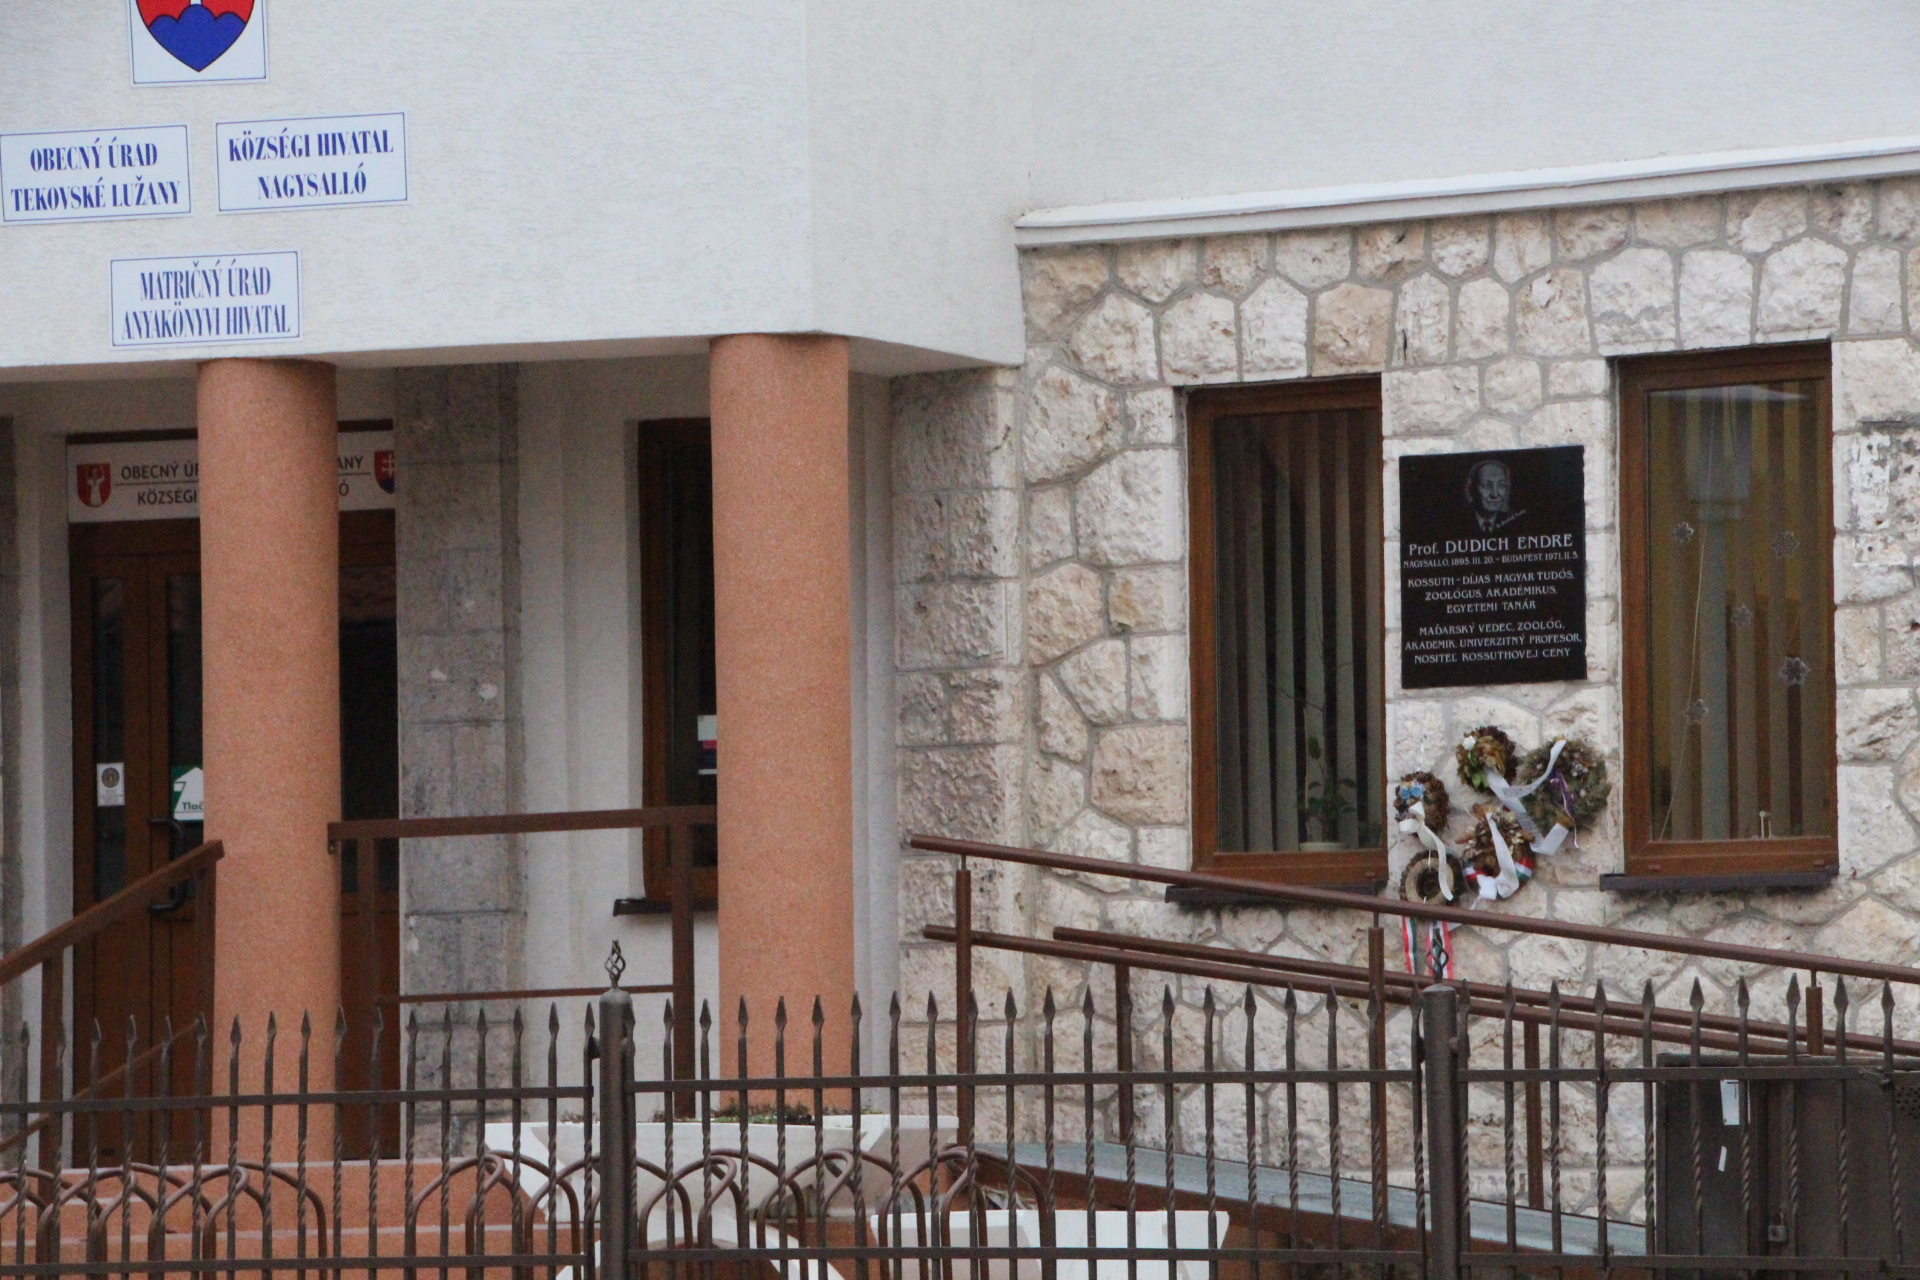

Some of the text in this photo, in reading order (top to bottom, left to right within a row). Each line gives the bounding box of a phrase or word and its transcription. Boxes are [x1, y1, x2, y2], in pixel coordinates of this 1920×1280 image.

[30, 136, 158, 172] OBECNÝ ÚRAD
[229, 127, 394, 162] KÖZSÉGI HIVATAL
[258, 162, 367, 200] NAGYSALLÓ
[11, 175, 180, 212] TEKOVSKÉ LUŽANY
[140, 258, 271, 300] MATRIČNÝ ÚRAD
[122, 301, 291, 340] ANYAKÖNYVI HIVATAL
[121, 461, 178, 480] OBECNÝ
[137, 487, 197, 505] KÖZSÉGI
[1409, 533, 1573, 556] Prof. DUDICH ENDRE
[1494, 572, 1535, 583] MAGYAR
[1486, 584, 1558, 597] AKADÉMIKUS,
[1446, 597, 1536, 614] EGYETEMI TANÁR
[1419, 617, 1566, 636] MAĎARSKÝ VEDEC, ZOOLÓG,
[1459, 633, 1525, 648] UNIVERZITNÝ
[1462, 649, 1539, 662] KOSSUTHOVEJ
[1542, 647, 1571, 658] CENY
